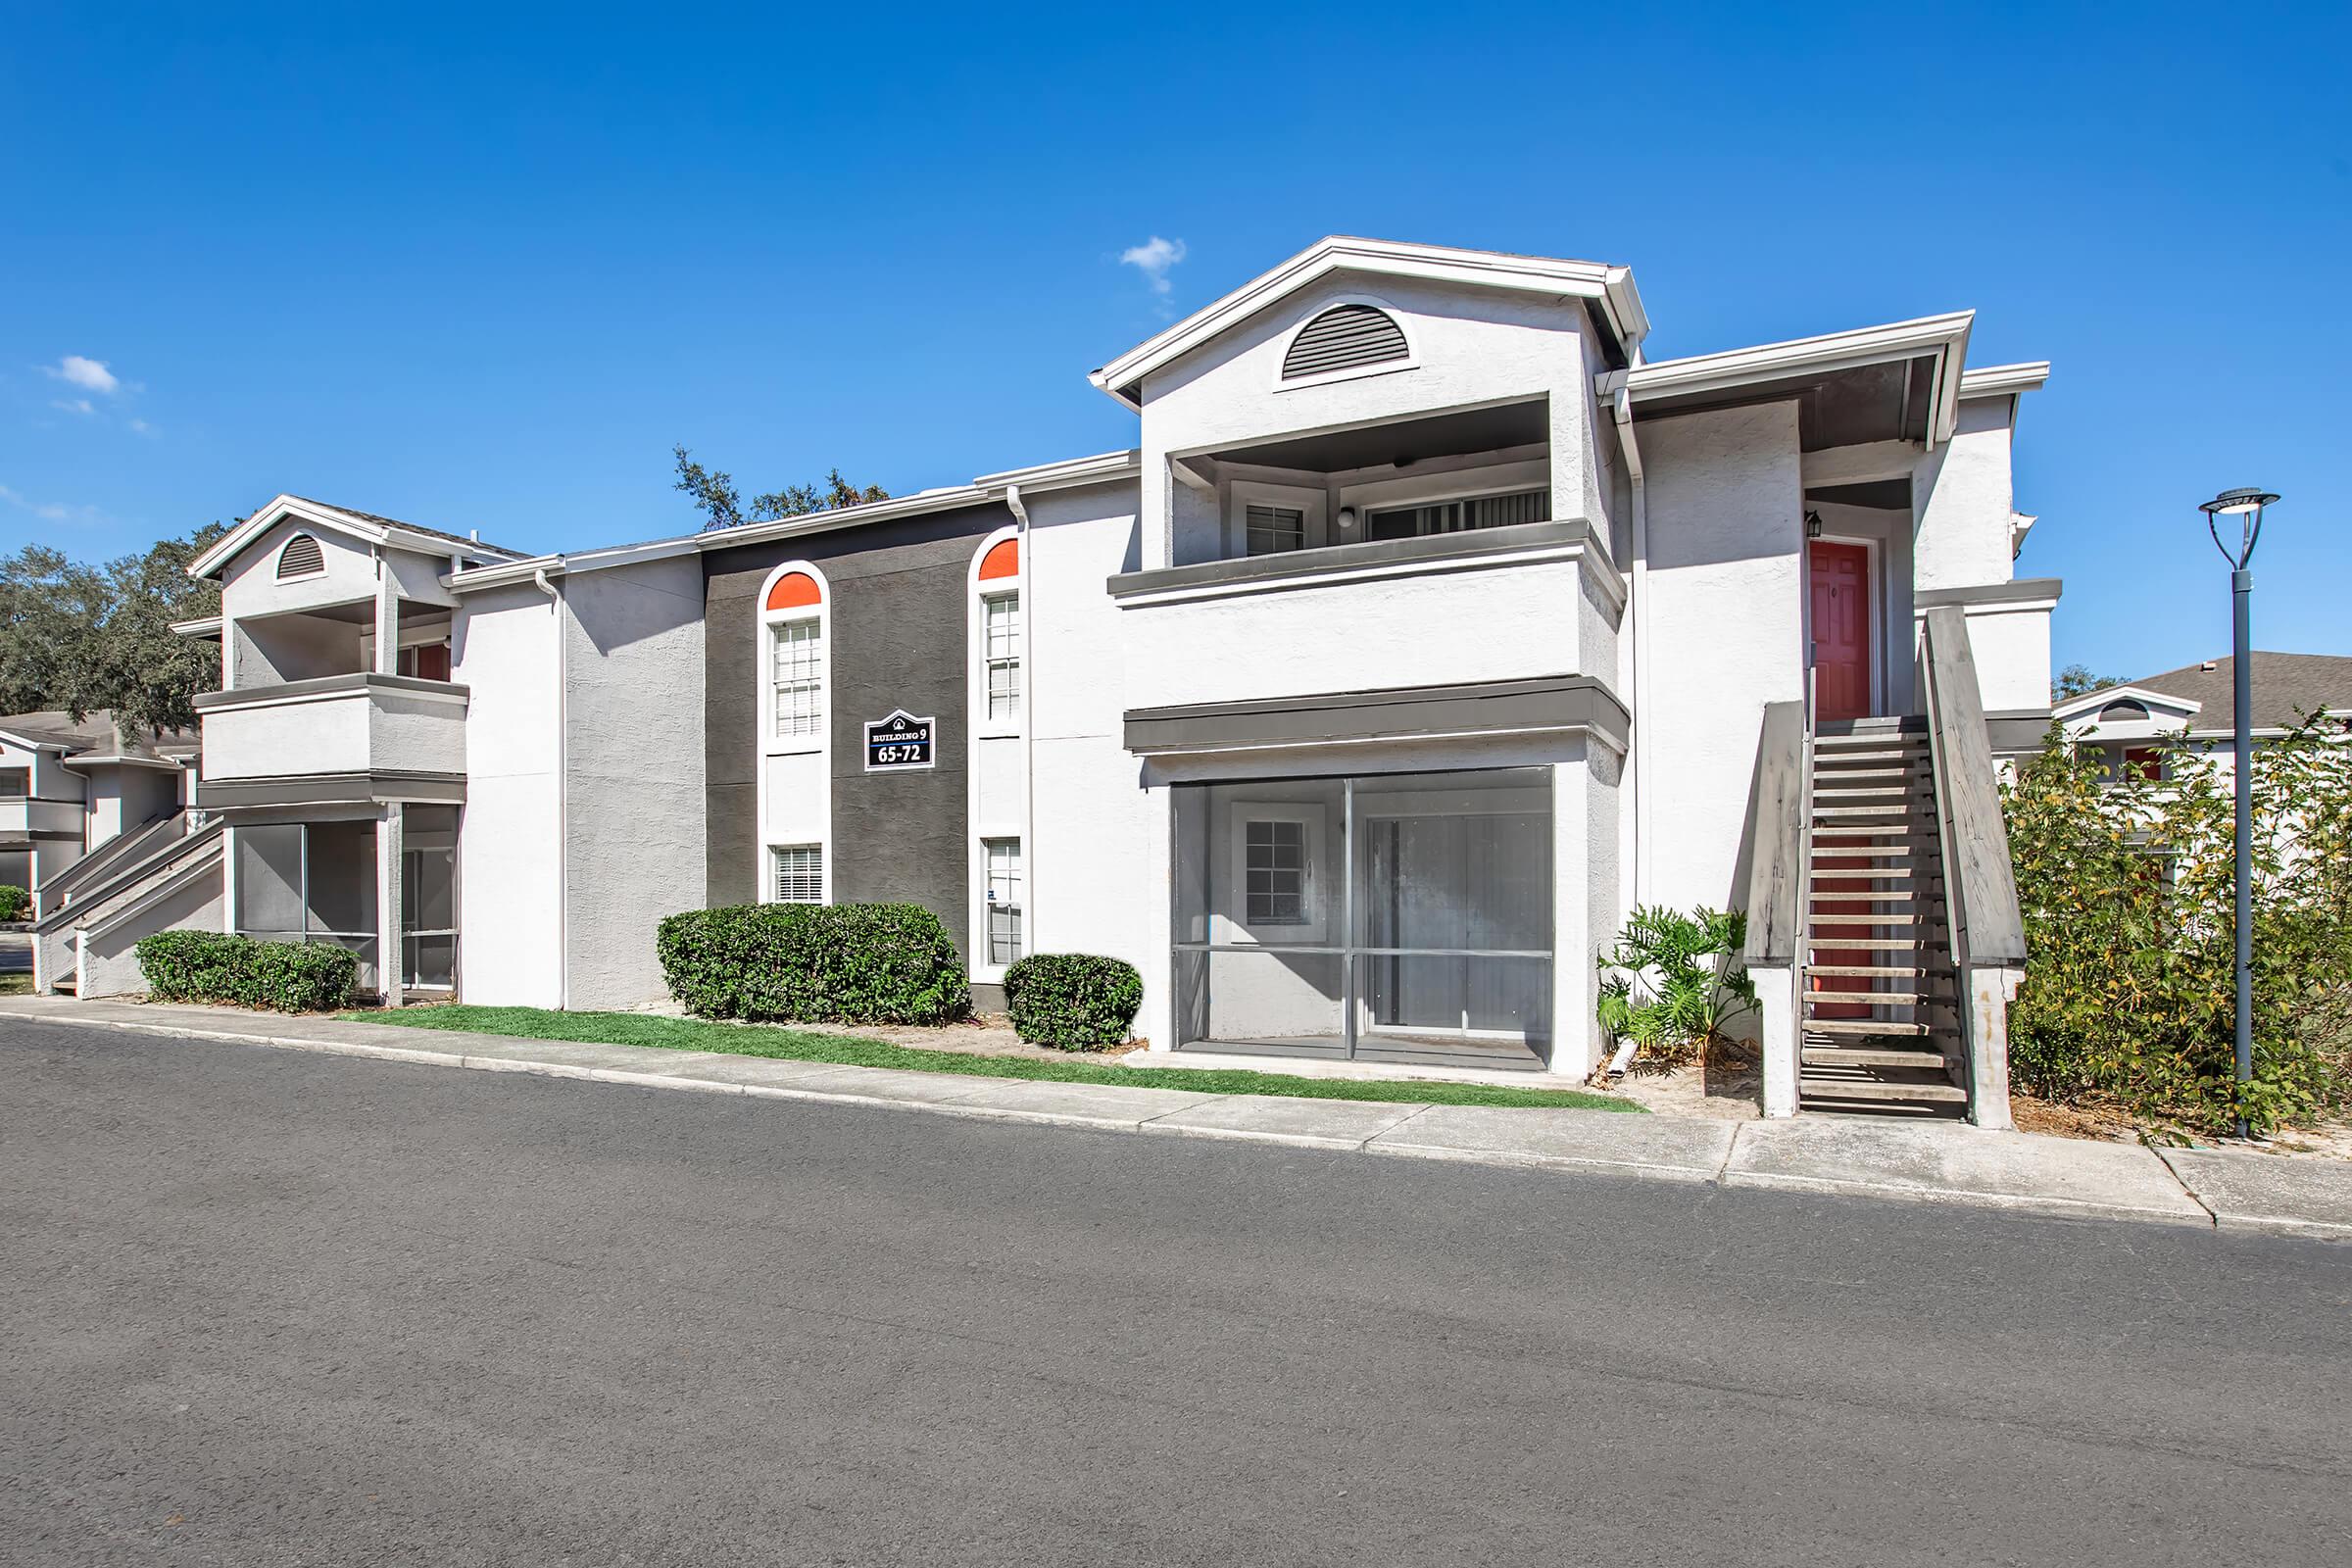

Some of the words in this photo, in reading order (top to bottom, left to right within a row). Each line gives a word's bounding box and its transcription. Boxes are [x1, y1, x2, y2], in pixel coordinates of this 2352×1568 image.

[872, 732, 919, 742] BUILDING
[919, 729, 927, 740] 9
[878, 745, 920, 762] 65-72
